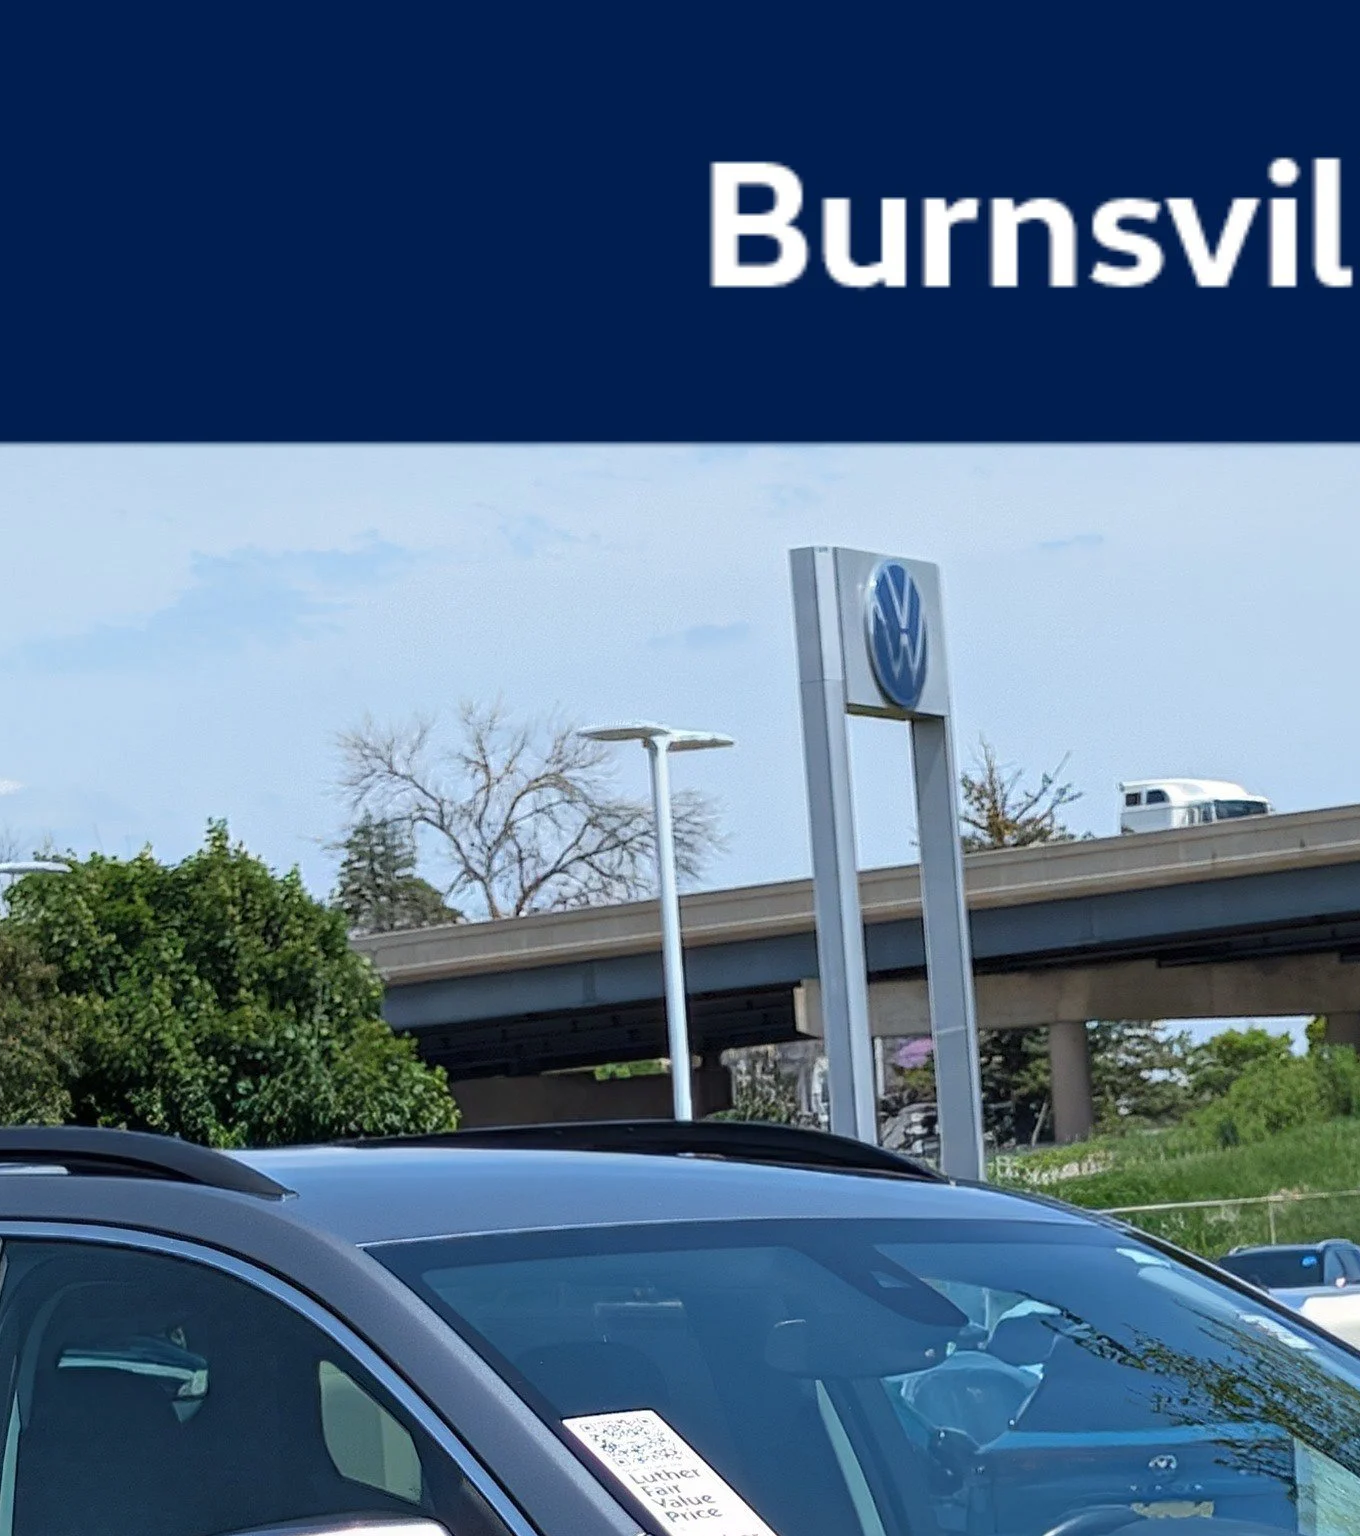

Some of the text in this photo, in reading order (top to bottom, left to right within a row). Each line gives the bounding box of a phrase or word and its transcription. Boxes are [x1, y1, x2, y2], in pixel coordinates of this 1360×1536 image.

[628, 1468, 701, 1485] Luther
[641, 1483, 682, 1497] Fair
[651, 1493, 717, 1509] Value
[665, 1506, 723, 1523] Price
